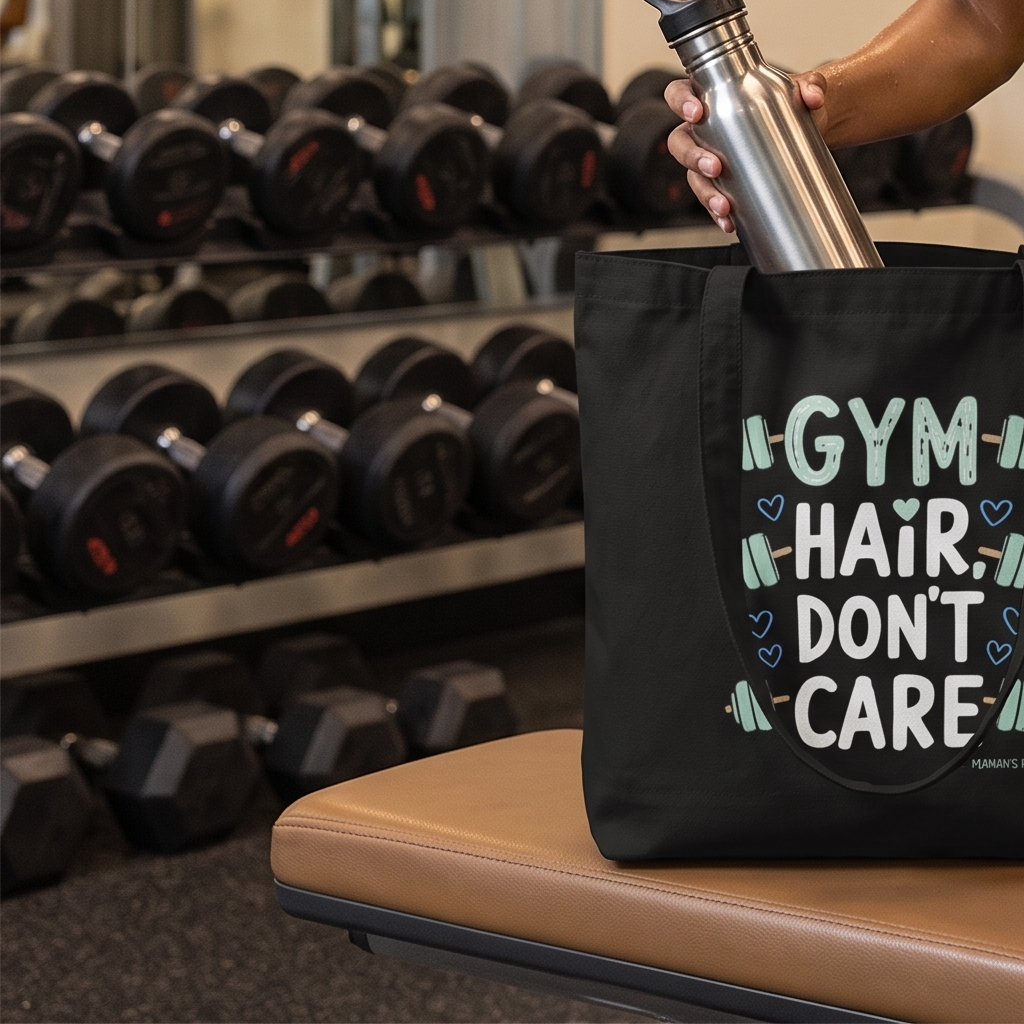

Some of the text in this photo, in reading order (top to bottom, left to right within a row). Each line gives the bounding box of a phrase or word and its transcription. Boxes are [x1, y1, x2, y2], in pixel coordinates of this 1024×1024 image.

[785, 395, 978, 487] GYM
[796, 586, 985, 663] DON'T
[794, 675, 984, 751] CARE
